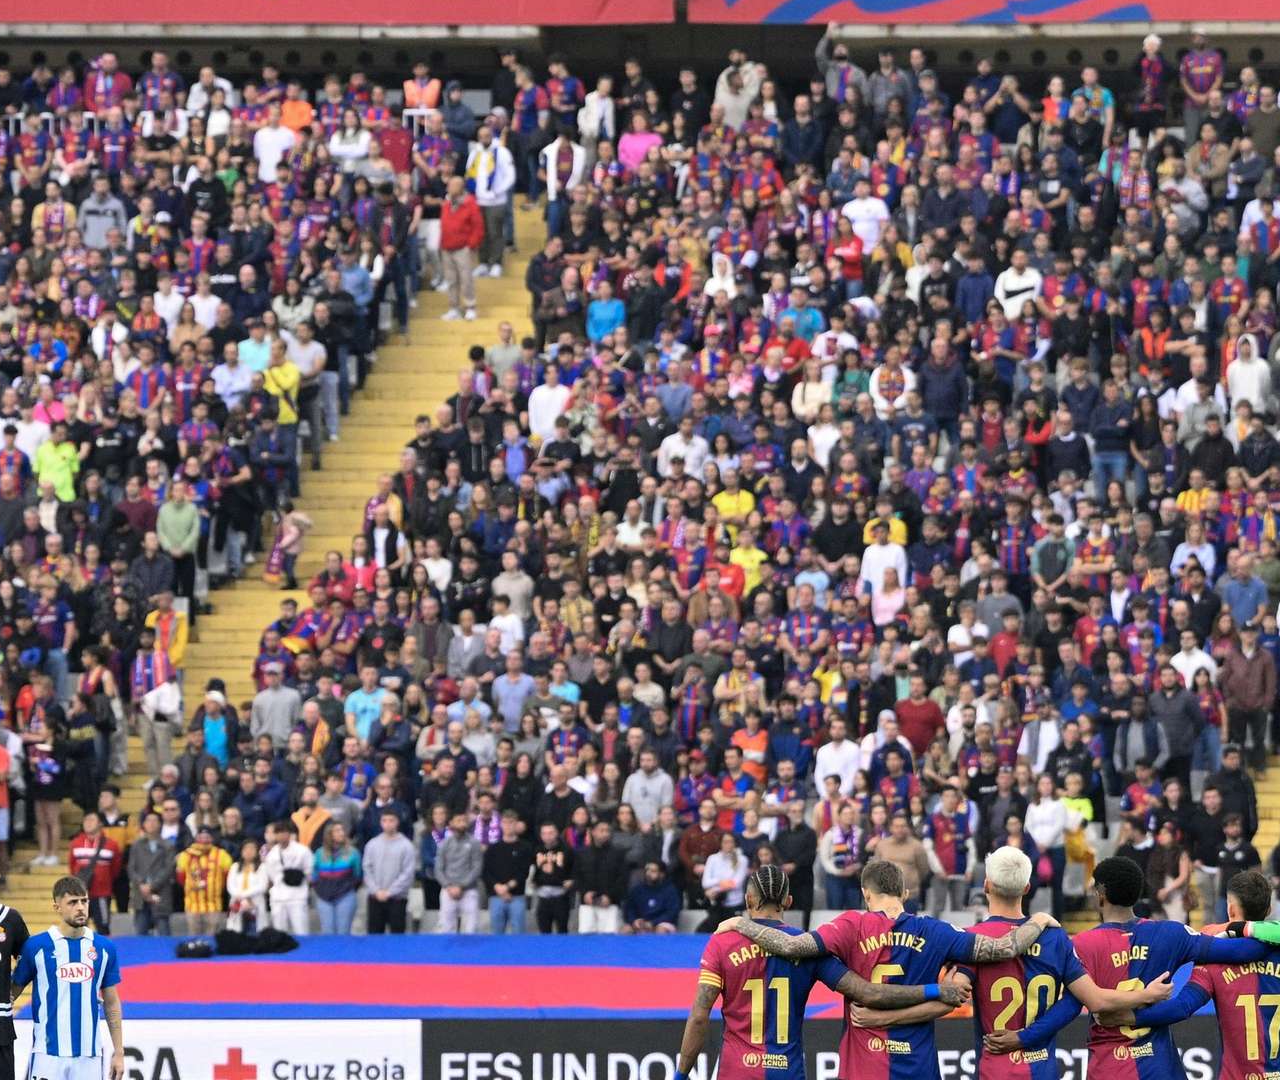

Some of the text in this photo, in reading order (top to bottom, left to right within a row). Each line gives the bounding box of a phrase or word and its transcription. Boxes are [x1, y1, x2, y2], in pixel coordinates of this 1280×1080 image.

[60, 966, 89, 978] DANI
[742, 976, 790, 1045] 11
[990, 974, 1056, 1032] 20
[272, 1059, 335, 1080] Cruz
